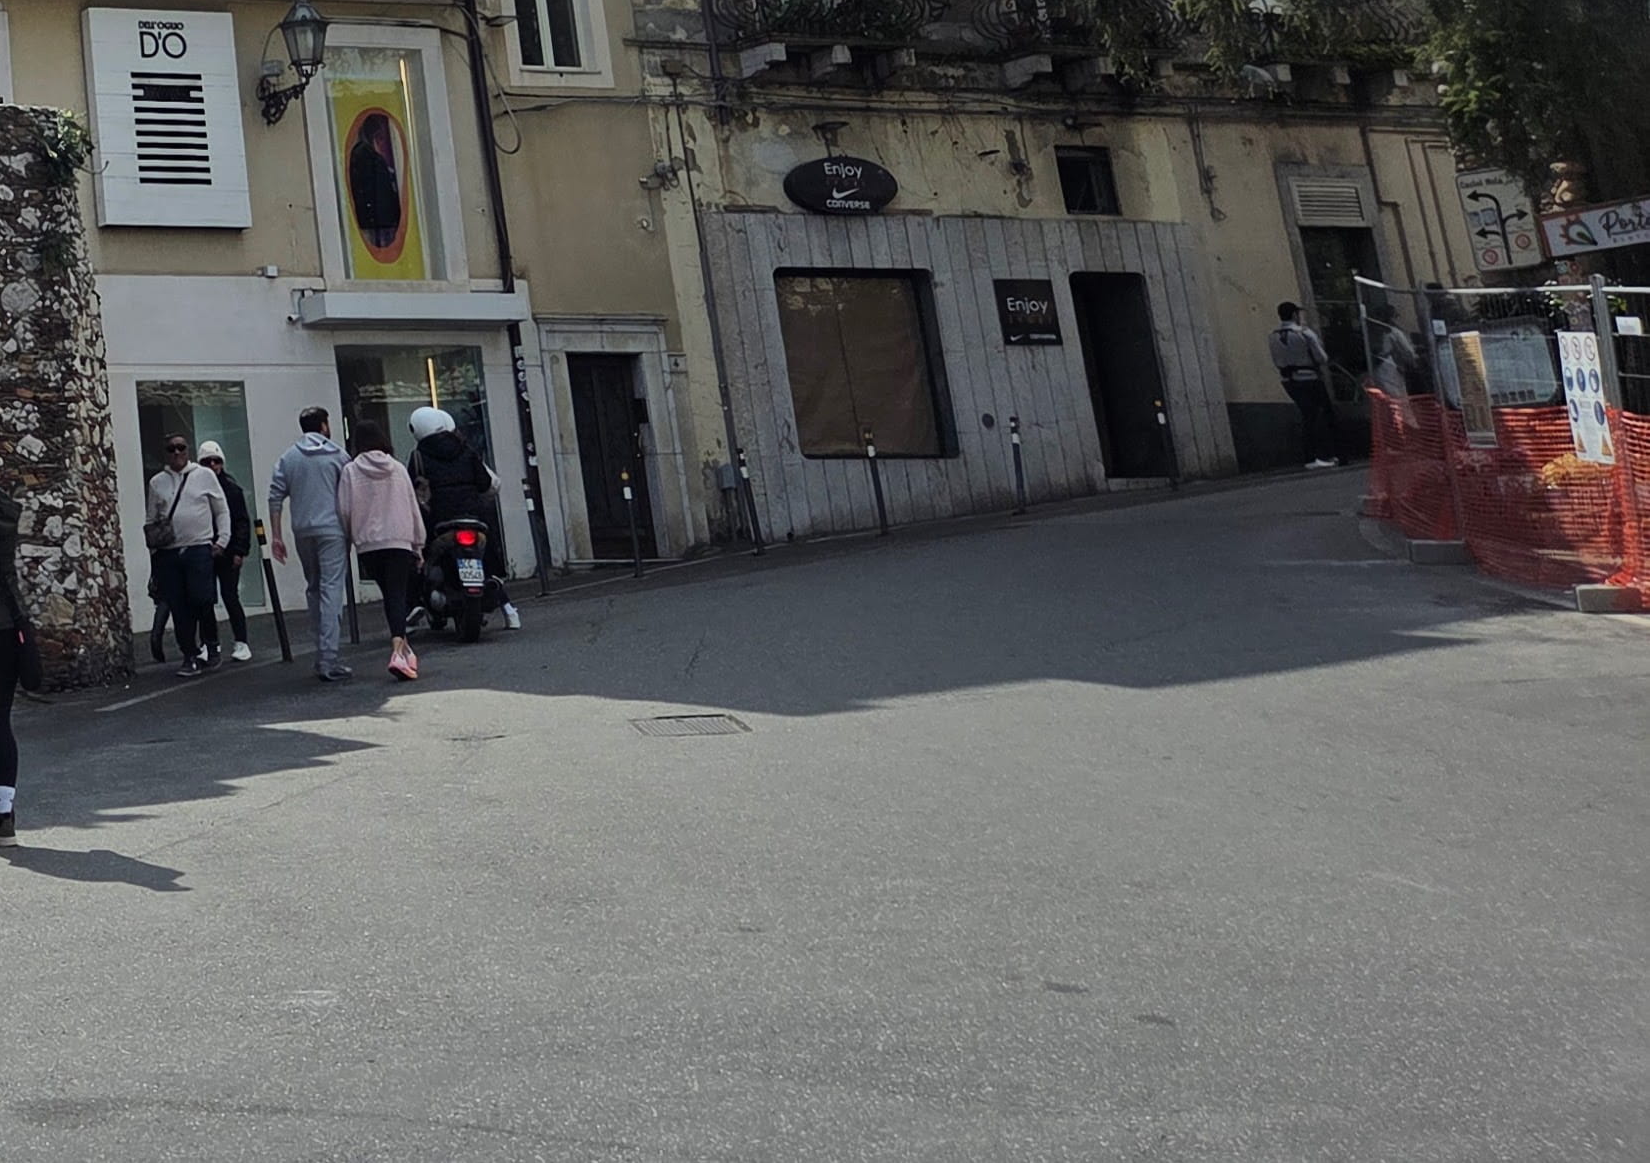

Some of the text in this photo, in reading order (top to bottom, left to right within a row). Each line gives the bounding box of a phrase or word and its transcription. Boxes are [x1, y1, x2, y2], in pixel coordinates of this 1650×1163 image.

[139, 30, 187, 59] D'O
[823, 162, 862, 179] Enjoy
[826, 199, 870, 209] CONVERSE
[1006, 297, 1048, 315] Enjoy
